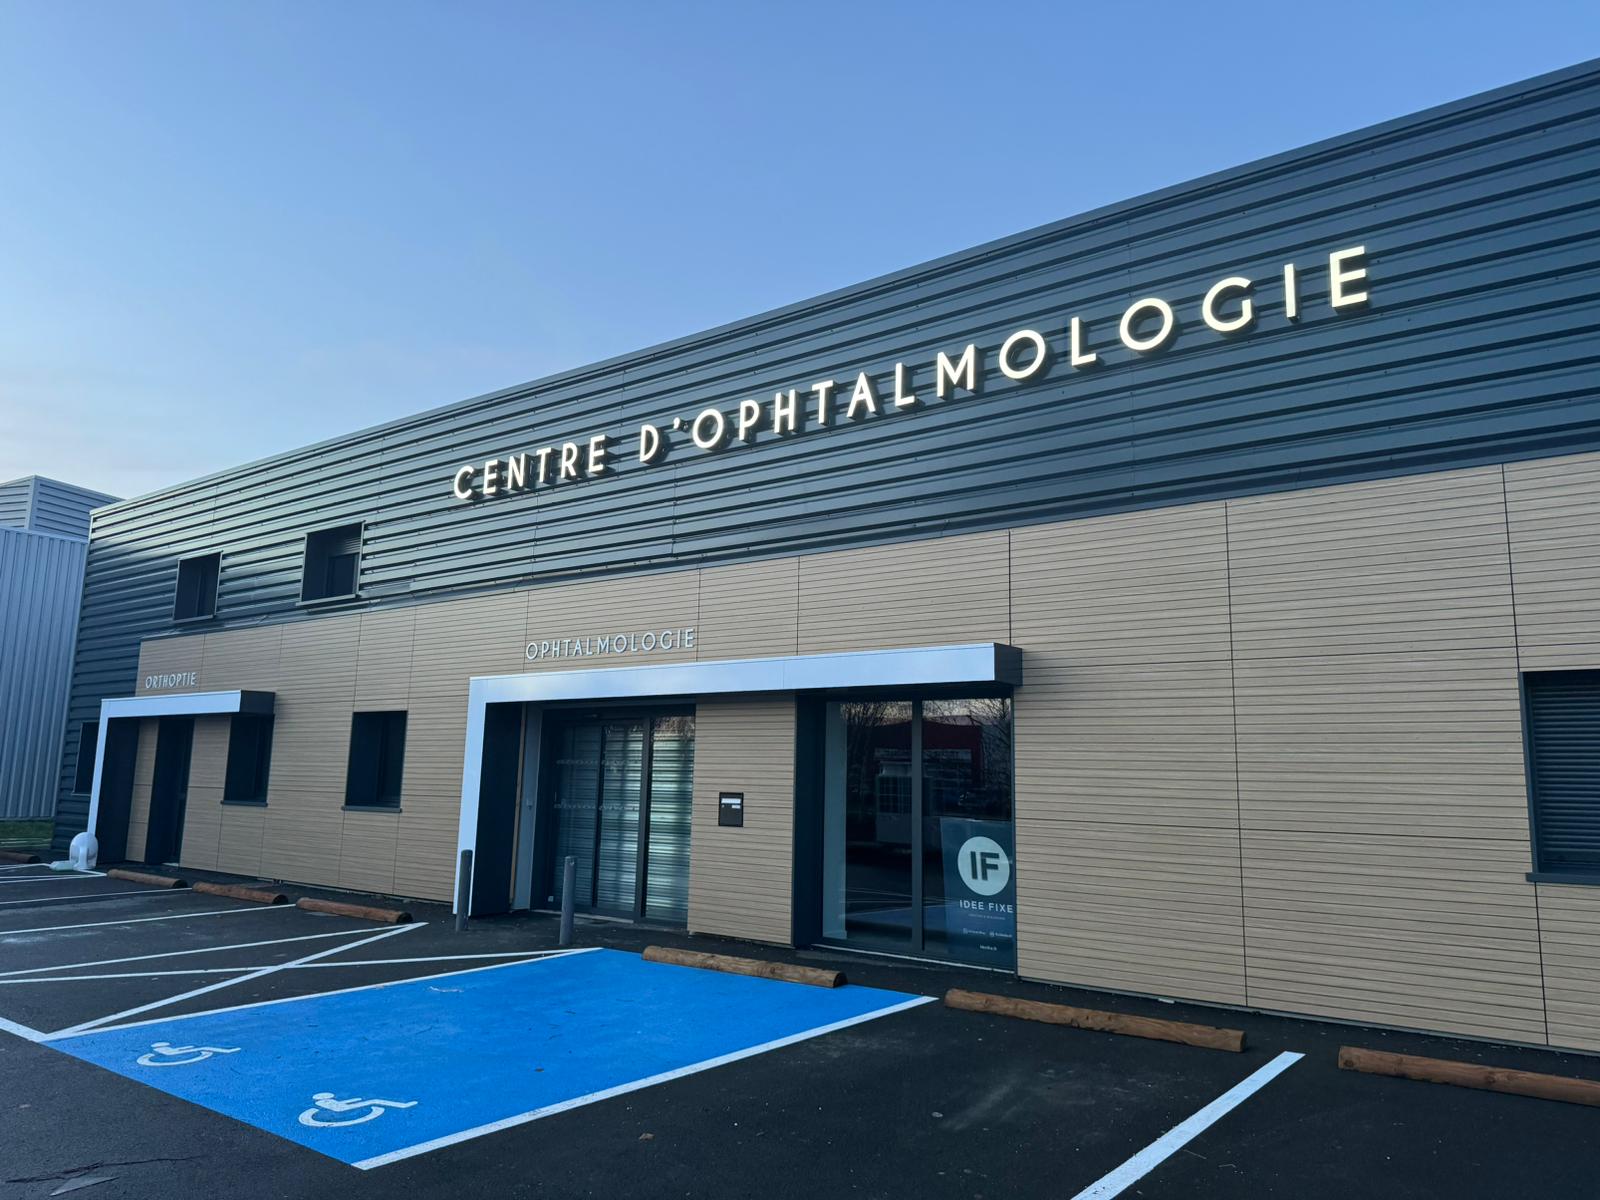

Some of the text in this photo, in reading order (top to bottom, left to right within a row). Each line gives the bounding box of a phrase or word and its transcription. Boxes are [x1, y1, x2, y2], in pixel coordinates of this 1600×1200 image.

[453, 245, 1369, 500] CENTRE D'OPHTALMOLOGIE
[525, 628, 696, 660] OPHTALMOLOGIE
[145, 672, 197, 689] ORTHOPTIE
[970, 850, 1000, 881] IF
[959, 899, 1014, 913] IDEE FIXE
